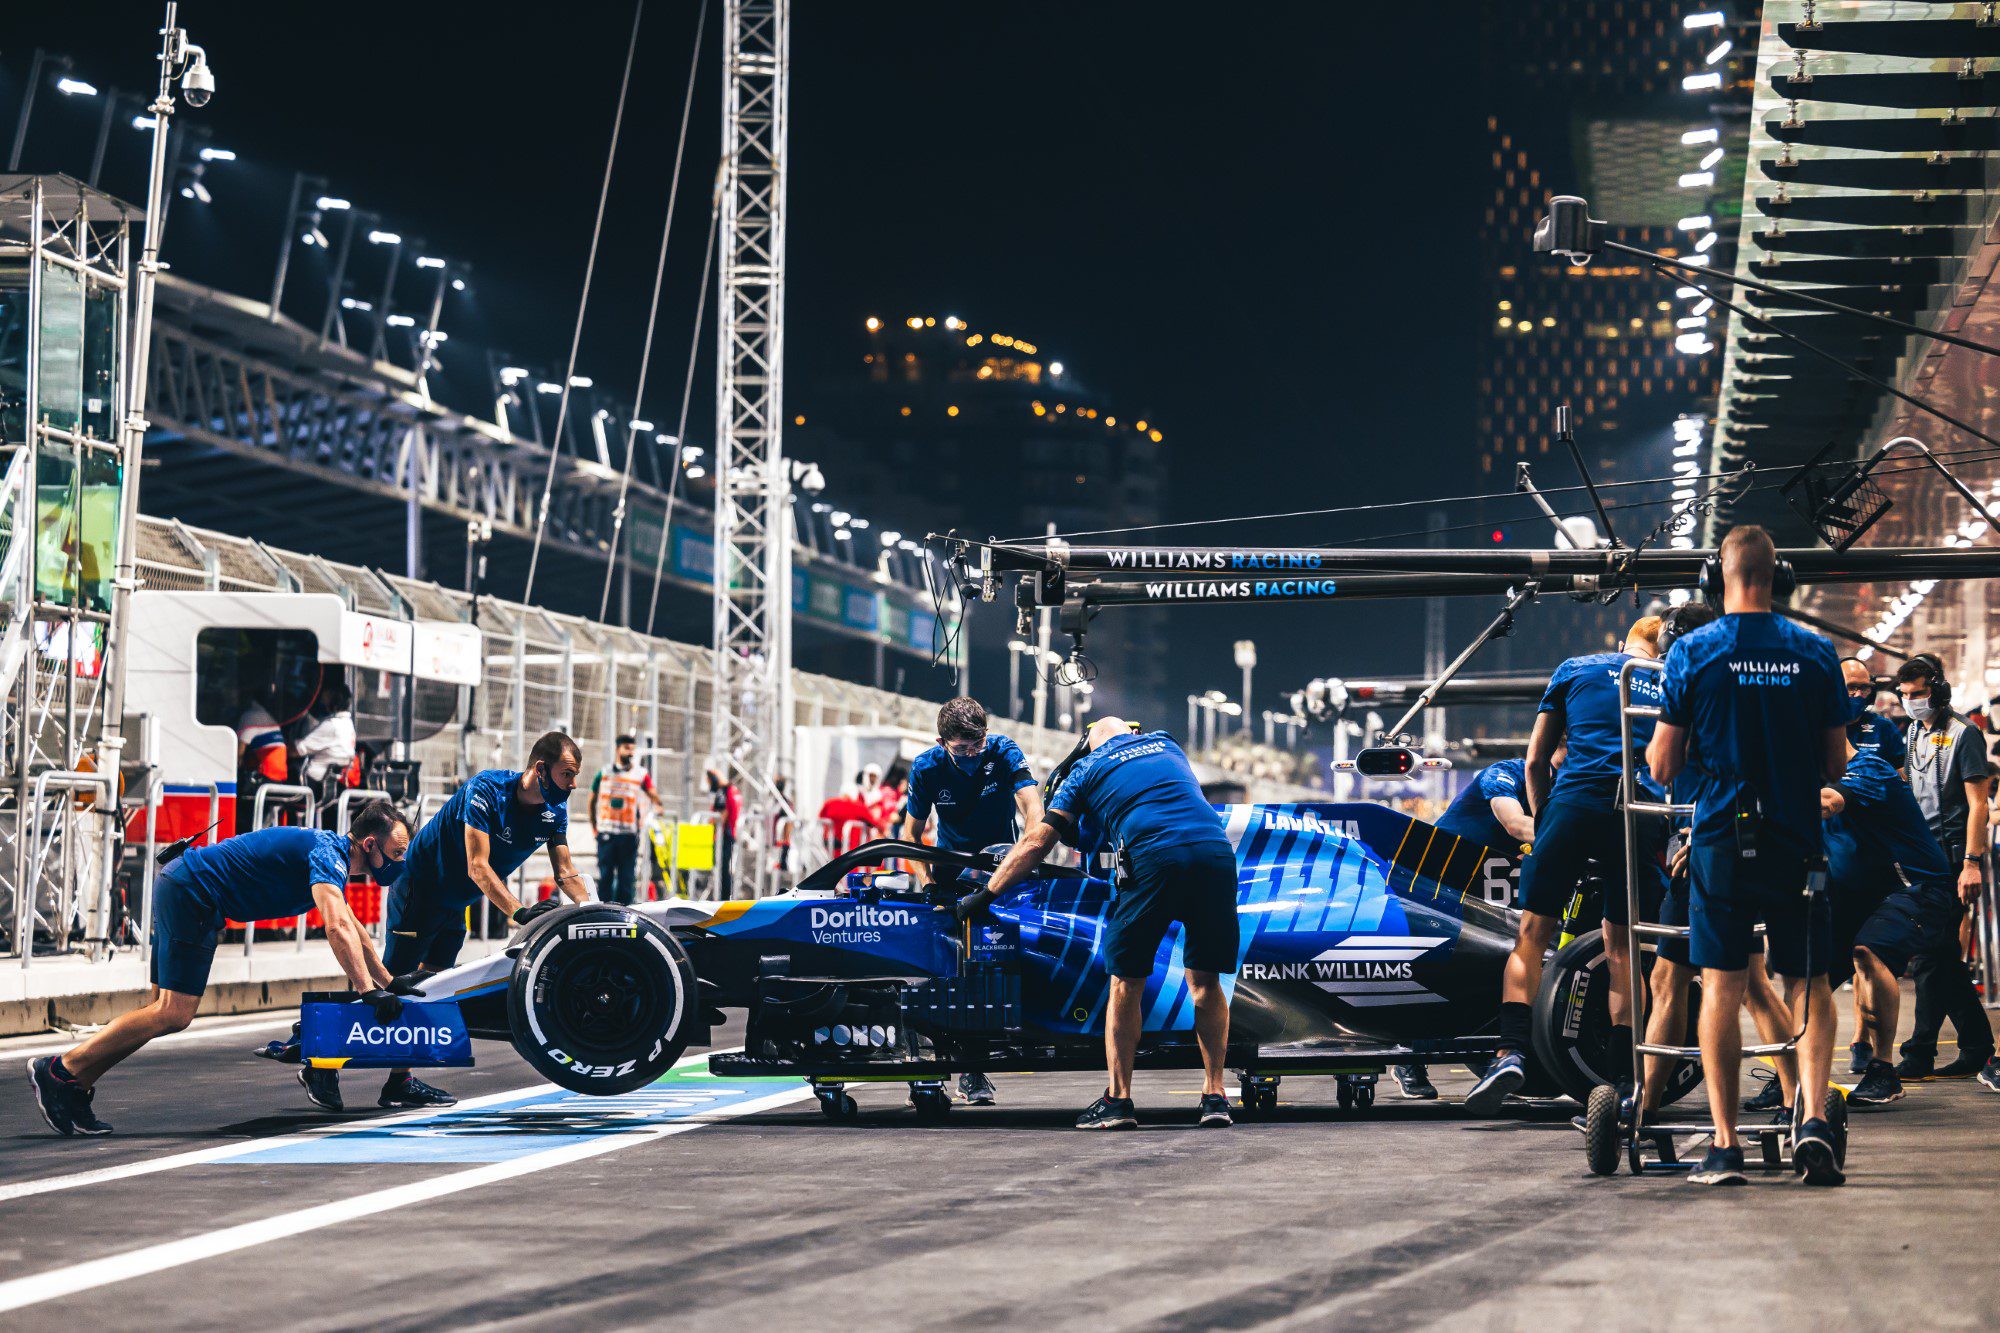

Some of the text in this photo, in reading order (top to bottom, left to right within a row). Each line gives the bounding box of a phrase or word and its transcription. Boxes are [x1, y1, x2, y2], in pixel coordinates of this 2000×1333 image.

[1106, 551, 1322, 569] WILLIAMS RACING
[1145, 580, 1336, 598] WILLIAMS RACING
[1729, 661, 1801, 675] WILLIAMS
[1613, 678, 1659, 700] RCING
[1738, 674, 1791, 686] RACING
[1108, 741, 1166, 760] WILLIAMS
[1119, 747, 1164, 763] RACING
[568, 922, 638, 940] PIRELLI
[812, 930, 882, 944] Ventures
[1242, 962, 1413, 980] FRANK WILLIAMS
[1562, 970, 1591, 1039] PIRELLI
[346, 1021, 452, 1046] Acronis
[814, 1024, 896, 1047] PONOS
[548, 1038, 662, 1078] P ZERO
